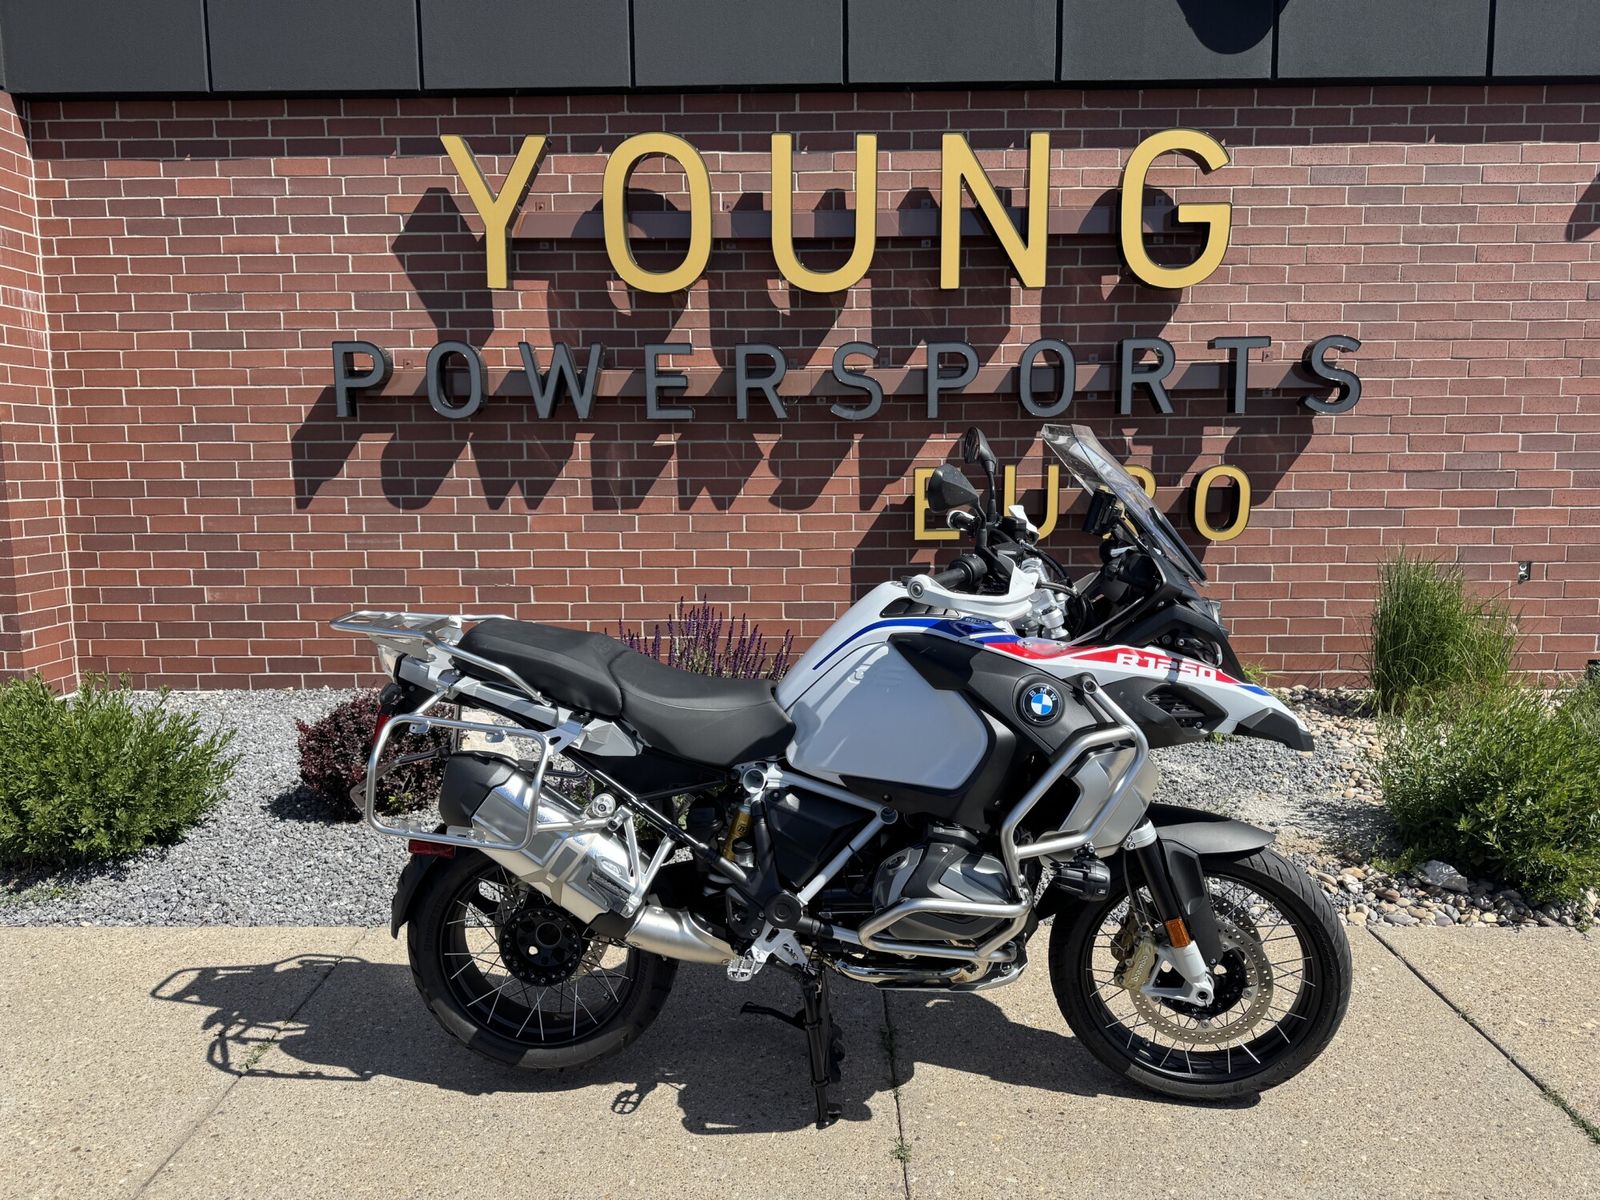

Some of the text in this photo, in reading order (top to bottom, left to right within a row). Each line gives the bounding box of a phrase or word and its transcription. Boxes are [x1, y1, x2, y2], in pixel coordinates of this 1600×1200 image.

[440, 129, 1233, 294] YOUNG
[332, 335, 1363, 421] POWERSPORTS
[1029, 687, 1057, 701] BMW
